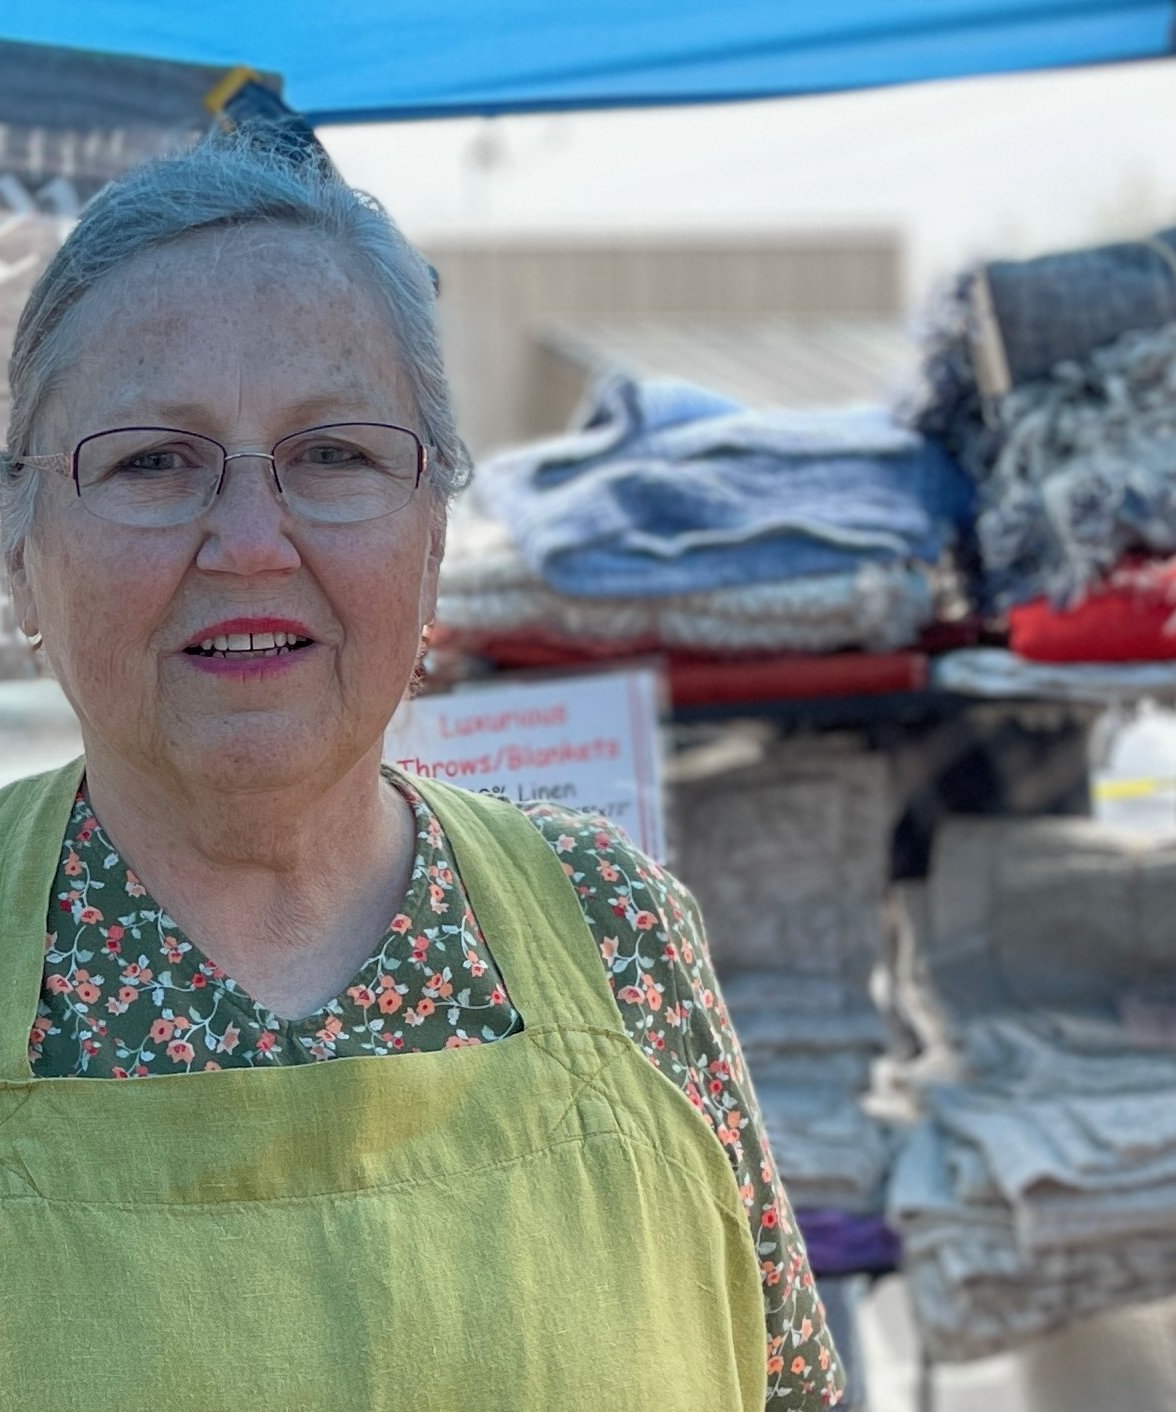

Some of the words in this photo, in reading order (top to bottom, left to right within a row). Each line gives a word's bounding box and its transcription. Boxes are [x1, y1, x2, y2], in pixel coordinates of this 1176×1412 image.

[438, 702, 568, 738] Luxurious
[396, 737, 620, 778] Throws/Blankets
[518, 781, 577, 802] Linen
